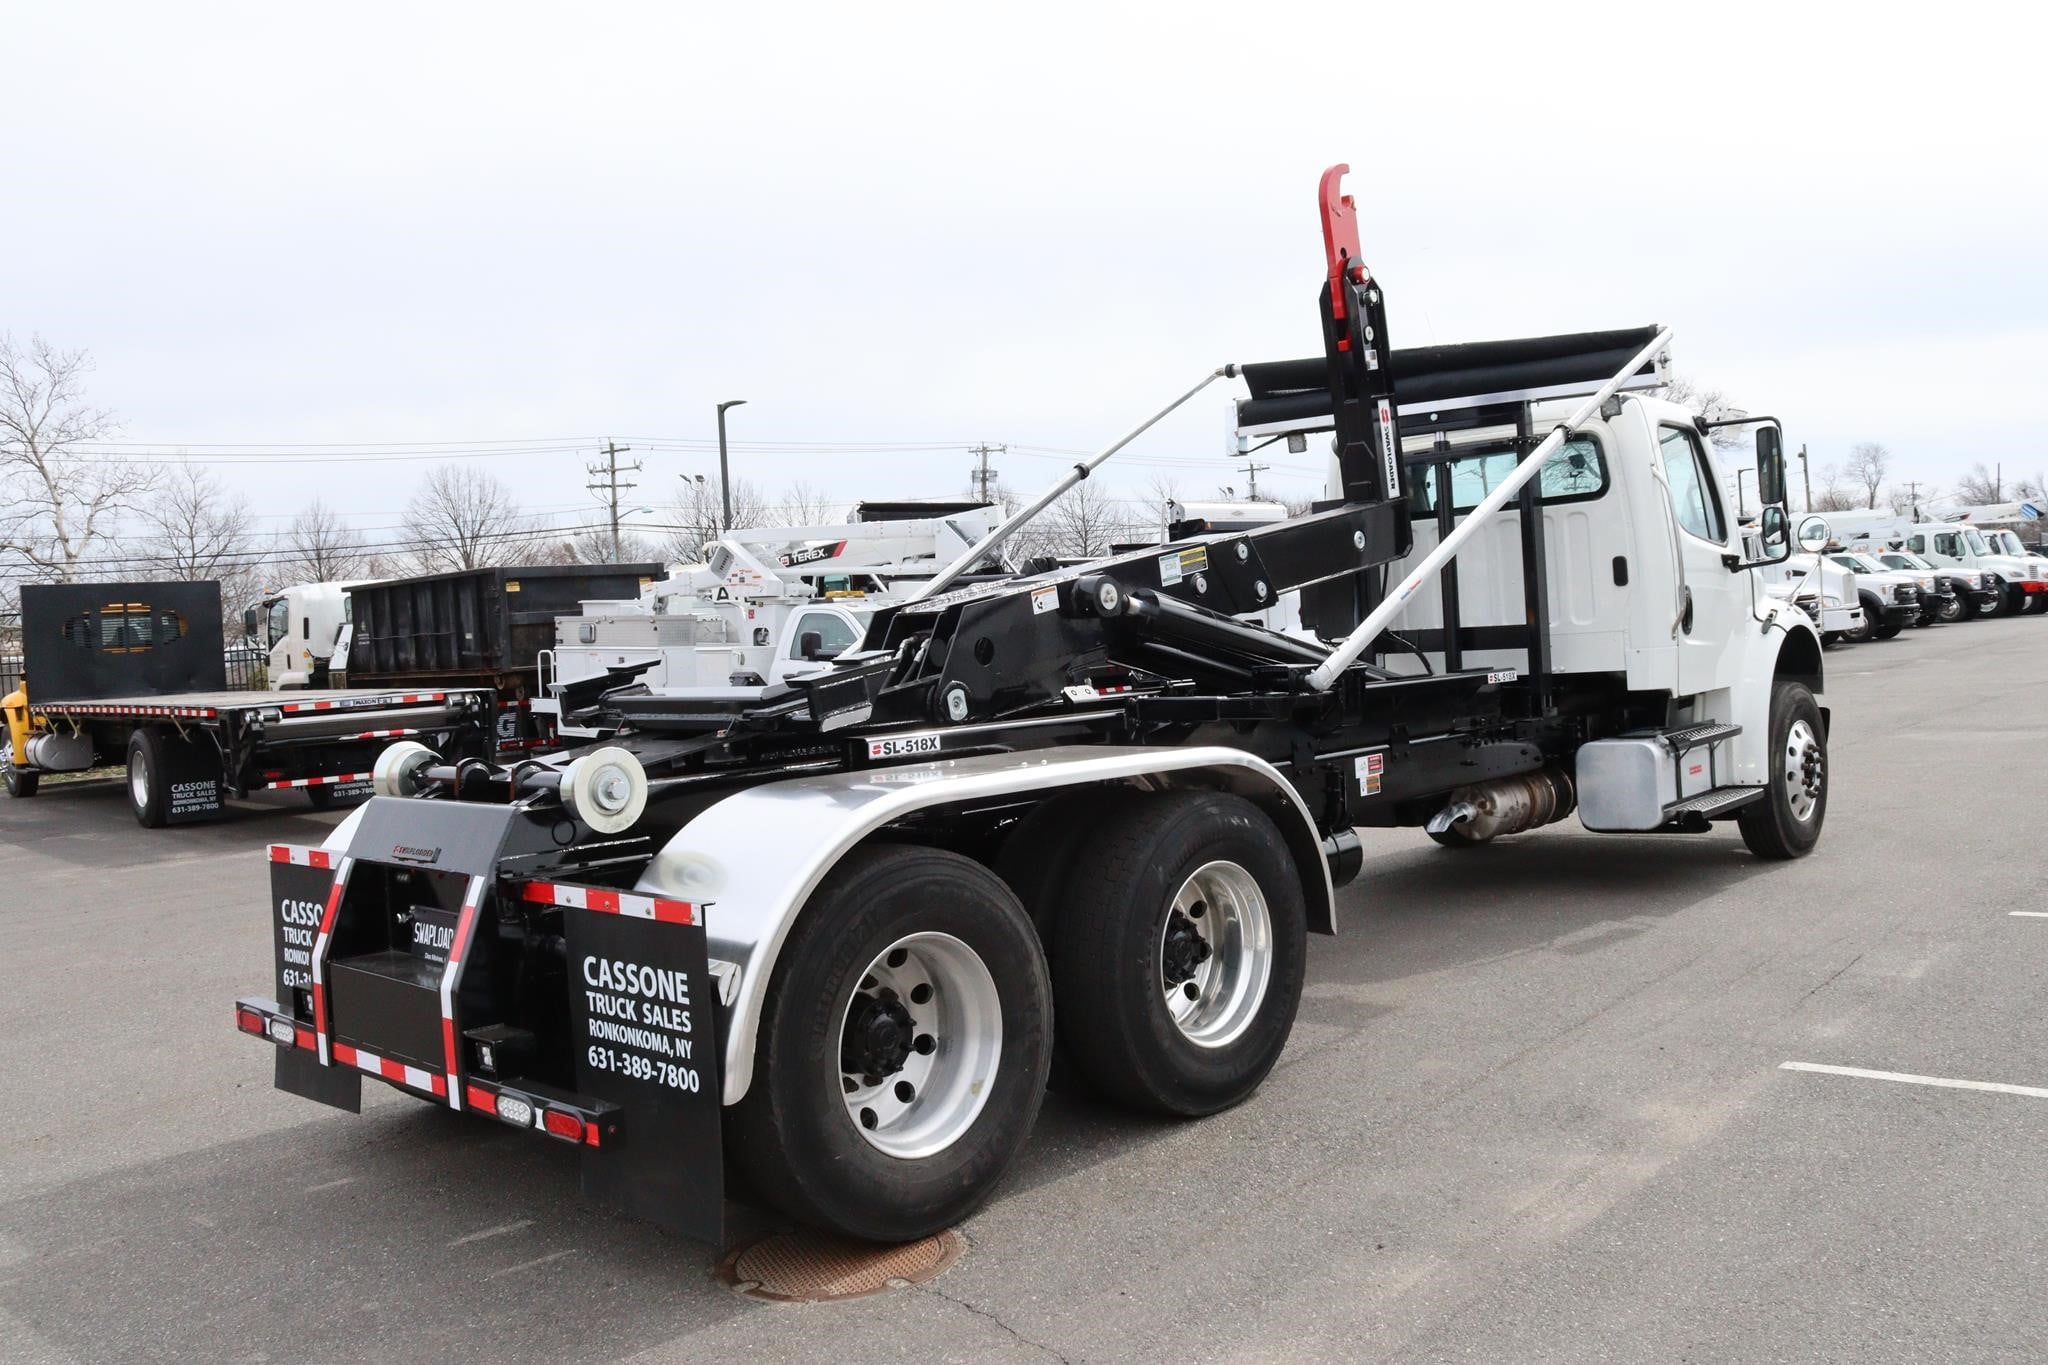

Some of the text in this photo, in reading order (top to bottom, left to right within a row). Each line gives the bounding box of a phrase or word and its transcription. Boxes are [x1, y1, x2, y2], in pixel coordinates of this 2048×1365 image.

[1384, 425, 1396, 490] SWAPLOADER
[791, 547, 827, 563] TEREX
[882, 737, 938, 756] SL-518X
[171, 781, 216, 792] CASSONE
[196, 789, 217, 797] SALES
[172, 803, 219, 813] 631-389-7800
[283, 926, 313, 947] TRUCK
[583, 955, 690, 1005] CASSONE
[585, 990, 692, 1033] TRUCK SALES
[588, 1018, 692, 1060] RONKONKOMA, NY
[588, 1045, 700, 1093] 631-389-7800
